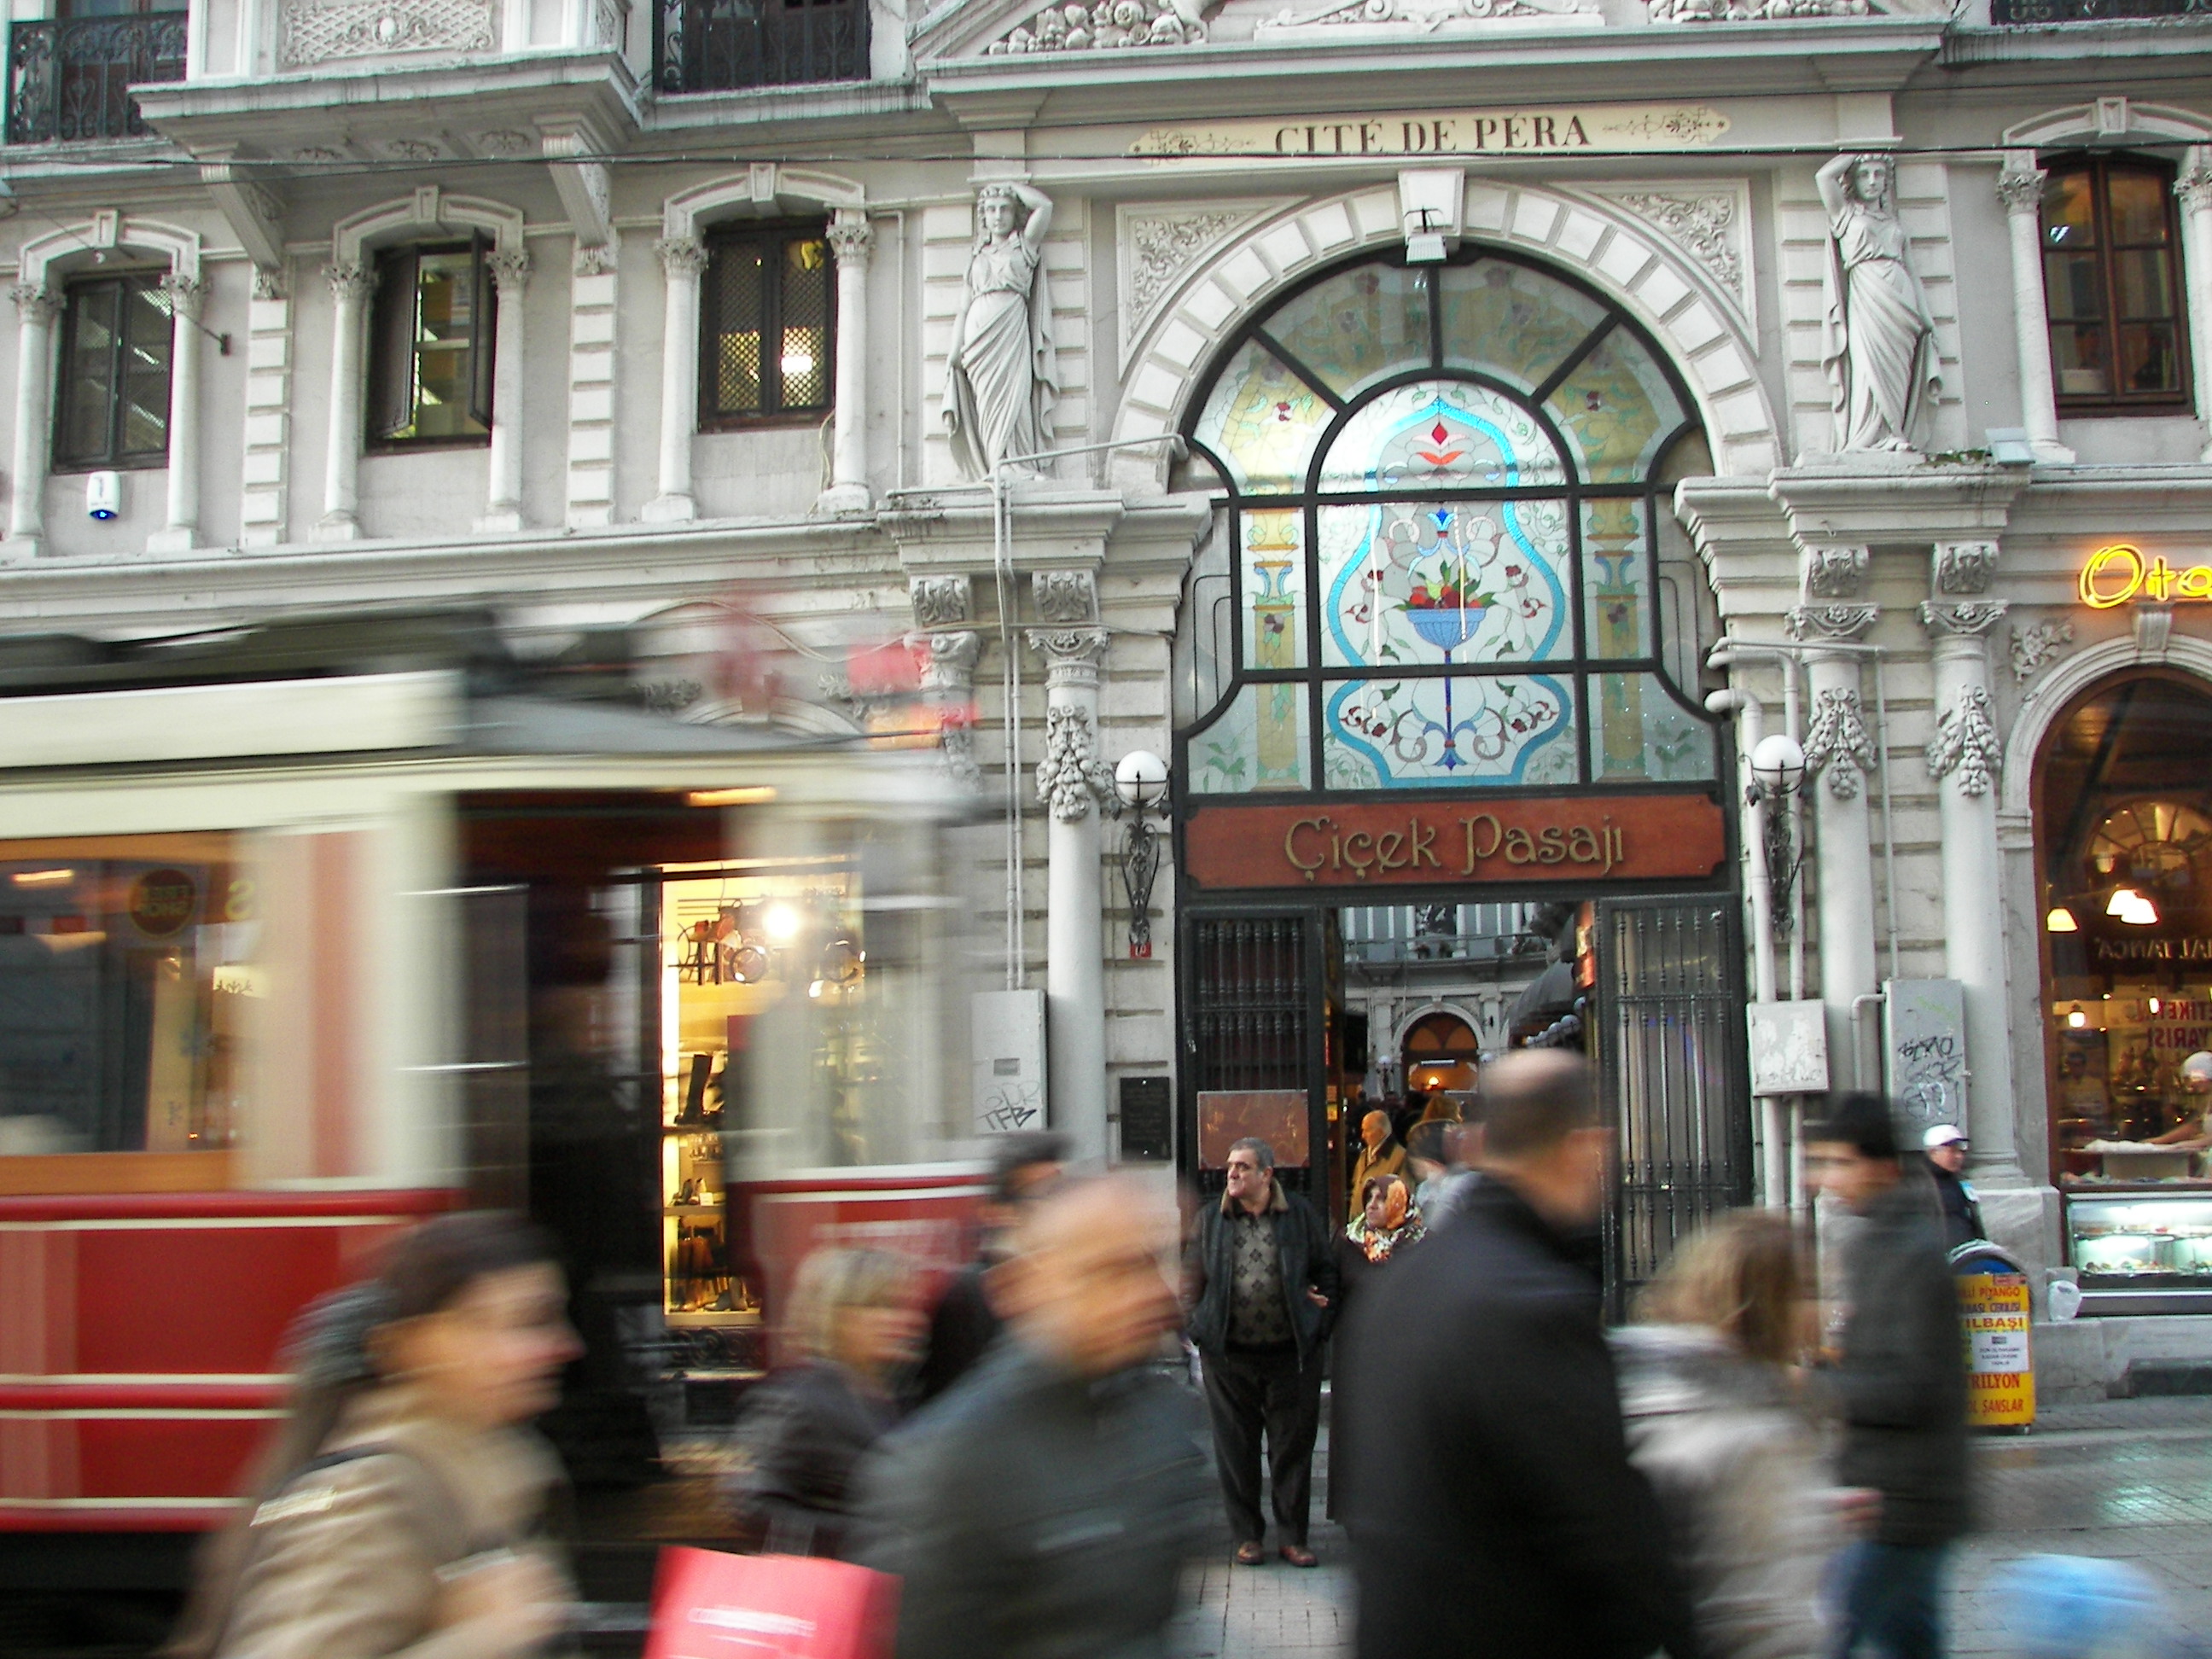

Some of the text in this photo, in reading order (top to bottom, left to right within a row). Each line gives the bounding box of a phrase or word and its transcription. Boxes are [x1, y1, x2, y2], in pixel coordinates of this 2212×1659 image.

[1275, 113, 1592, 153] CITÉ DE PÉRA
[1284, 813, 1623, 882] Çiçek Pasajı
[1965, 1317, 2023, 1330] ILBAŞI
